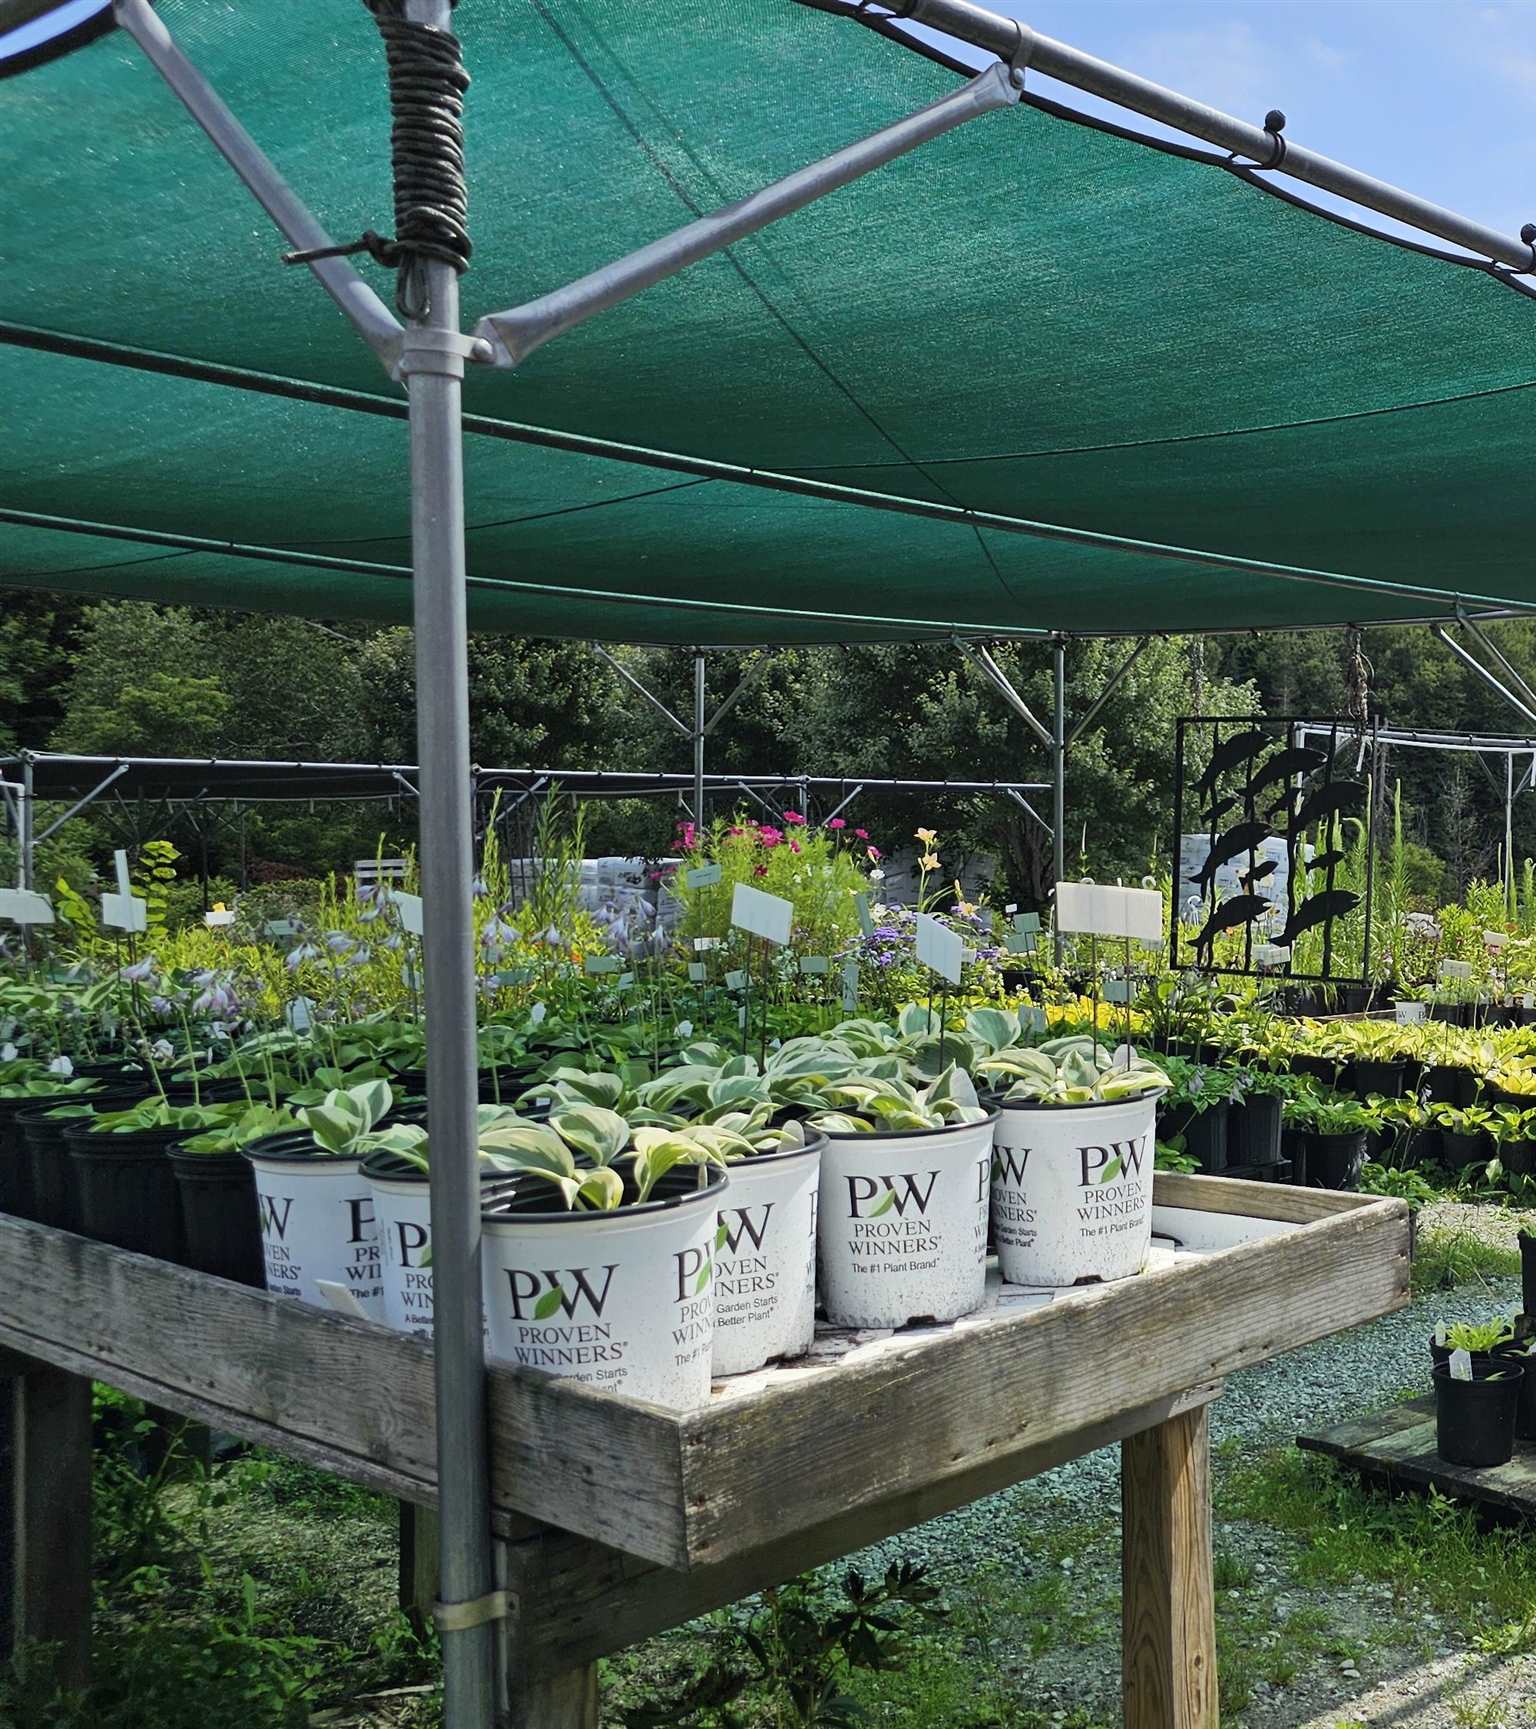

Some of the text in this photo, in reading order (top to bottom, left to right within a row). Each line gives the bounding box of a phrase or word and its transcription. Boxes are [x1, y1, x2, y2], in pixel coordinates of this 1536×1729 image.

[991, 1144, 1033, 1187] W
[1075, 1135, 1149, 1187] PW
[842, 1170, 942, 1219] PW
[1085, 1180, 1142, 1204] PROVEN
[259, 1192, 296, 1241] W
[717, 1202, 776, 1255] W
[854, 1218, 932, 1239] PROVEN
[393, 1220, 432, 1268] P
[1080, 1227, 1096, 1237] The
[852, 1263, 868, 1274] The
[870, 1263, 881, 1273] #1
[883, 1261, 908, 1273] Plant
[503, 1263, 621, 1321] PW
[717, 1295, 778, 1314] Garden Starts
[518, 1322, 612, 1345] PROVEN
[718, 1316, 745, 1327] Better
[596, 1367, 629, 1382] Starts
